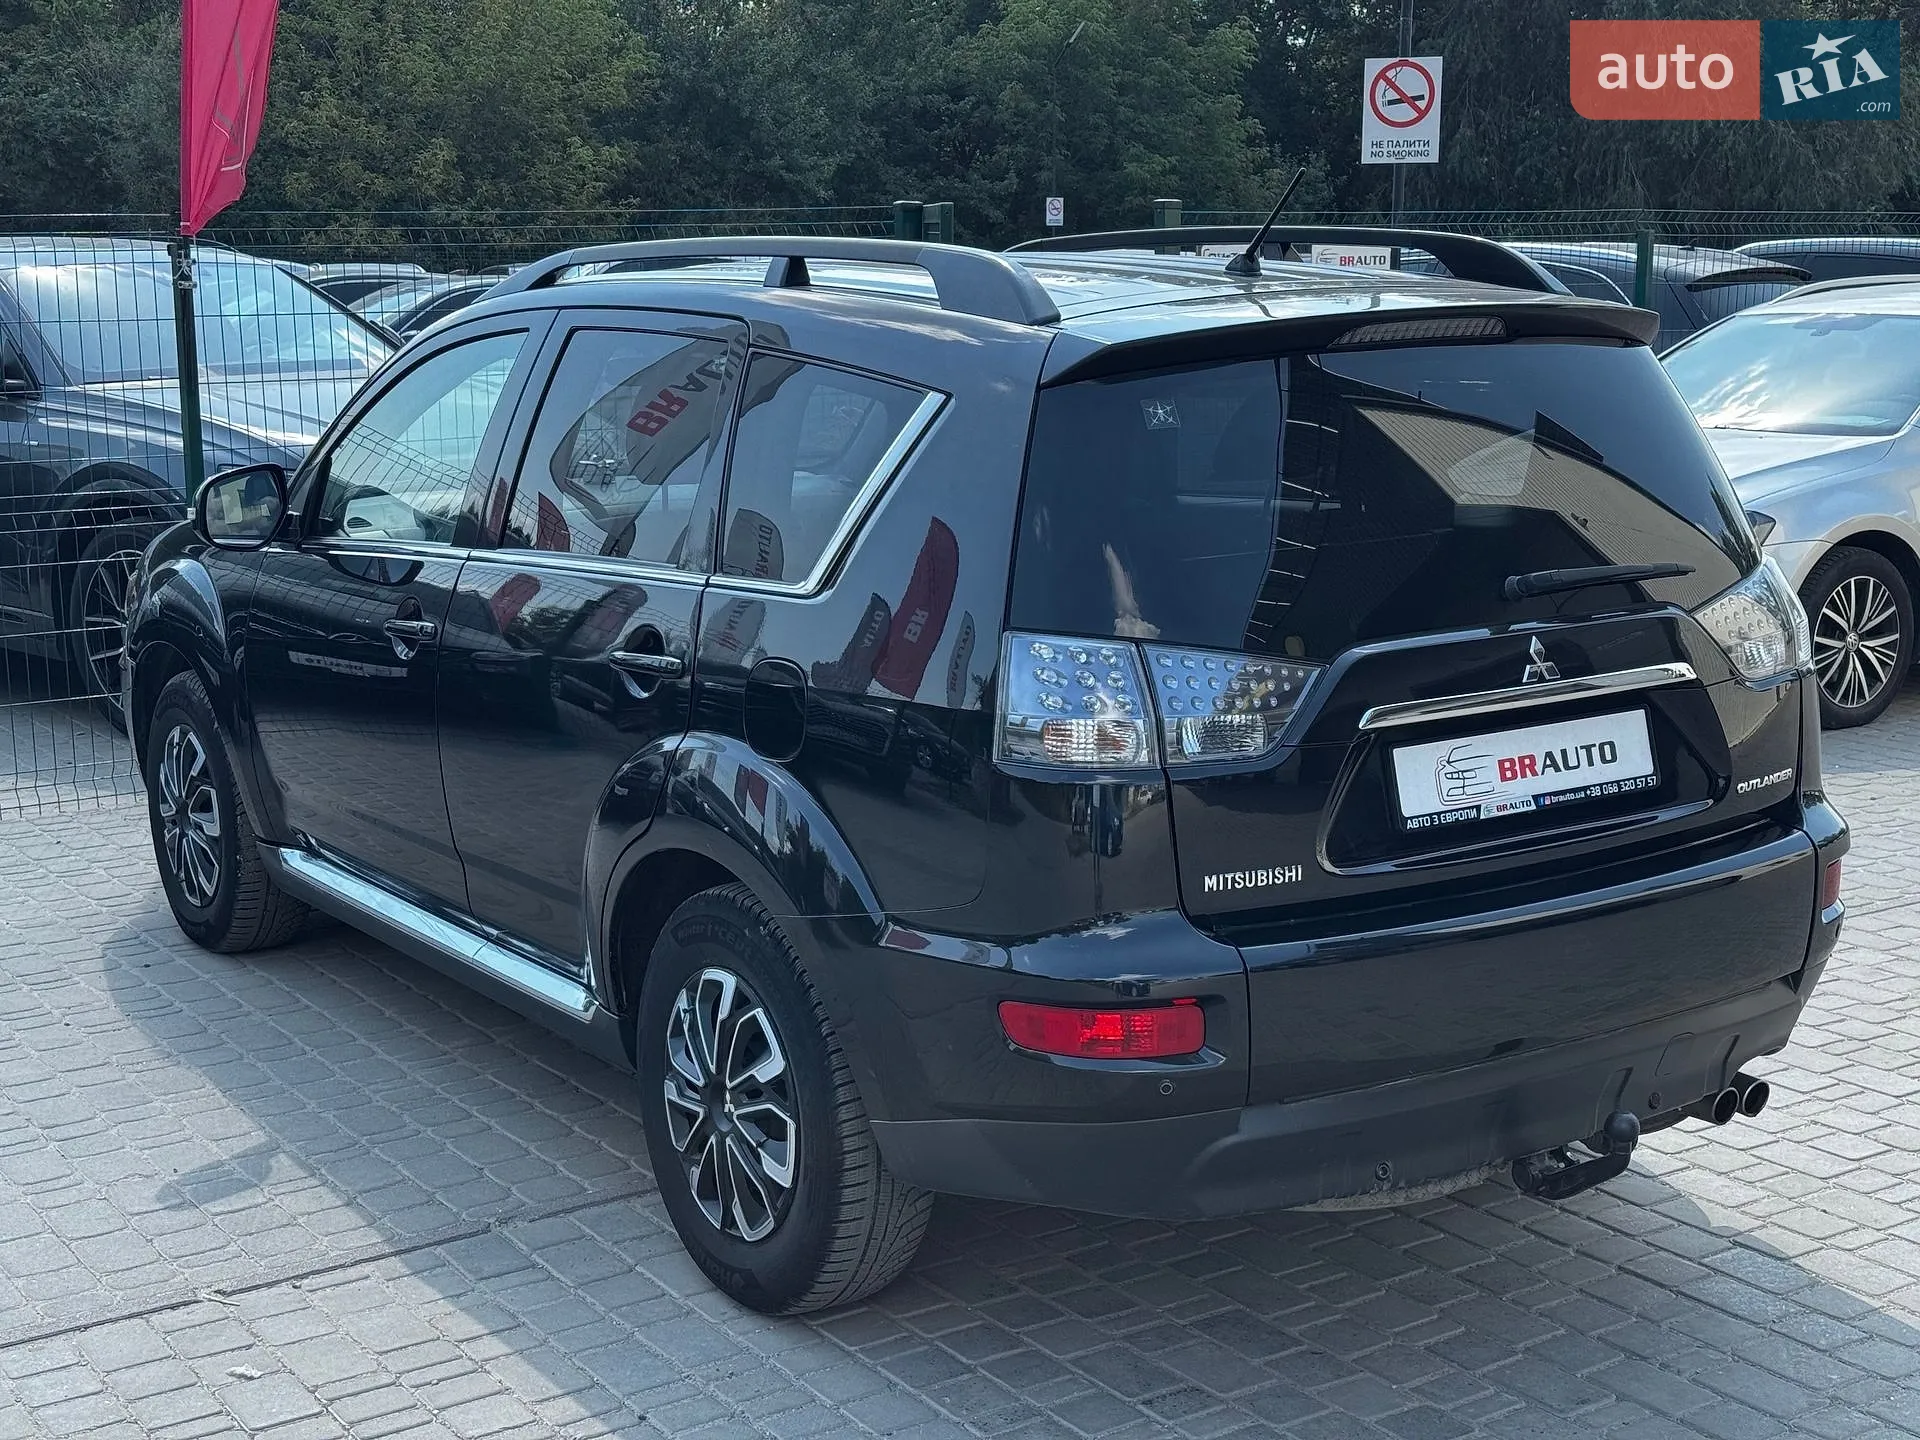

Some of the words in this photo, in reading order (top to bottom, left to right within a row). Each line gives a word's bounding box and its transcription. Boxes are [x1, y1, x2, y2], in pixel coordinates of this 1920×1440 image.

[1370, 150, 1385, 158] NO
[1386, 150, 1430, 158] SMOKING
[1371, 140, 1385, 149] НЕ
[1387, 140, 1431, 149] ПАЛИТИ
[1340, 255, 1387, 267] BRAUTO
[1497, 740, 1618, 783] BRAUTO
[1551, 790, 1585, 803] brauto.ua
[1586, 785, 1601, 797] +38
[1620, 779, 1636, 791] 320
[1636, 778, 1646, 788] 57
[1647, 775, 1657, 786] 57
[1737, 768, 1793, 793] OUTLANDER
[1496, 799, 1532, 813] BRAUTO
[1406, 815, 1431, 830] АВТО
[1440, 807, 1478, 824] ЄВРОПИ
[1204, 865, 1302, 892] MITSUBISHI
